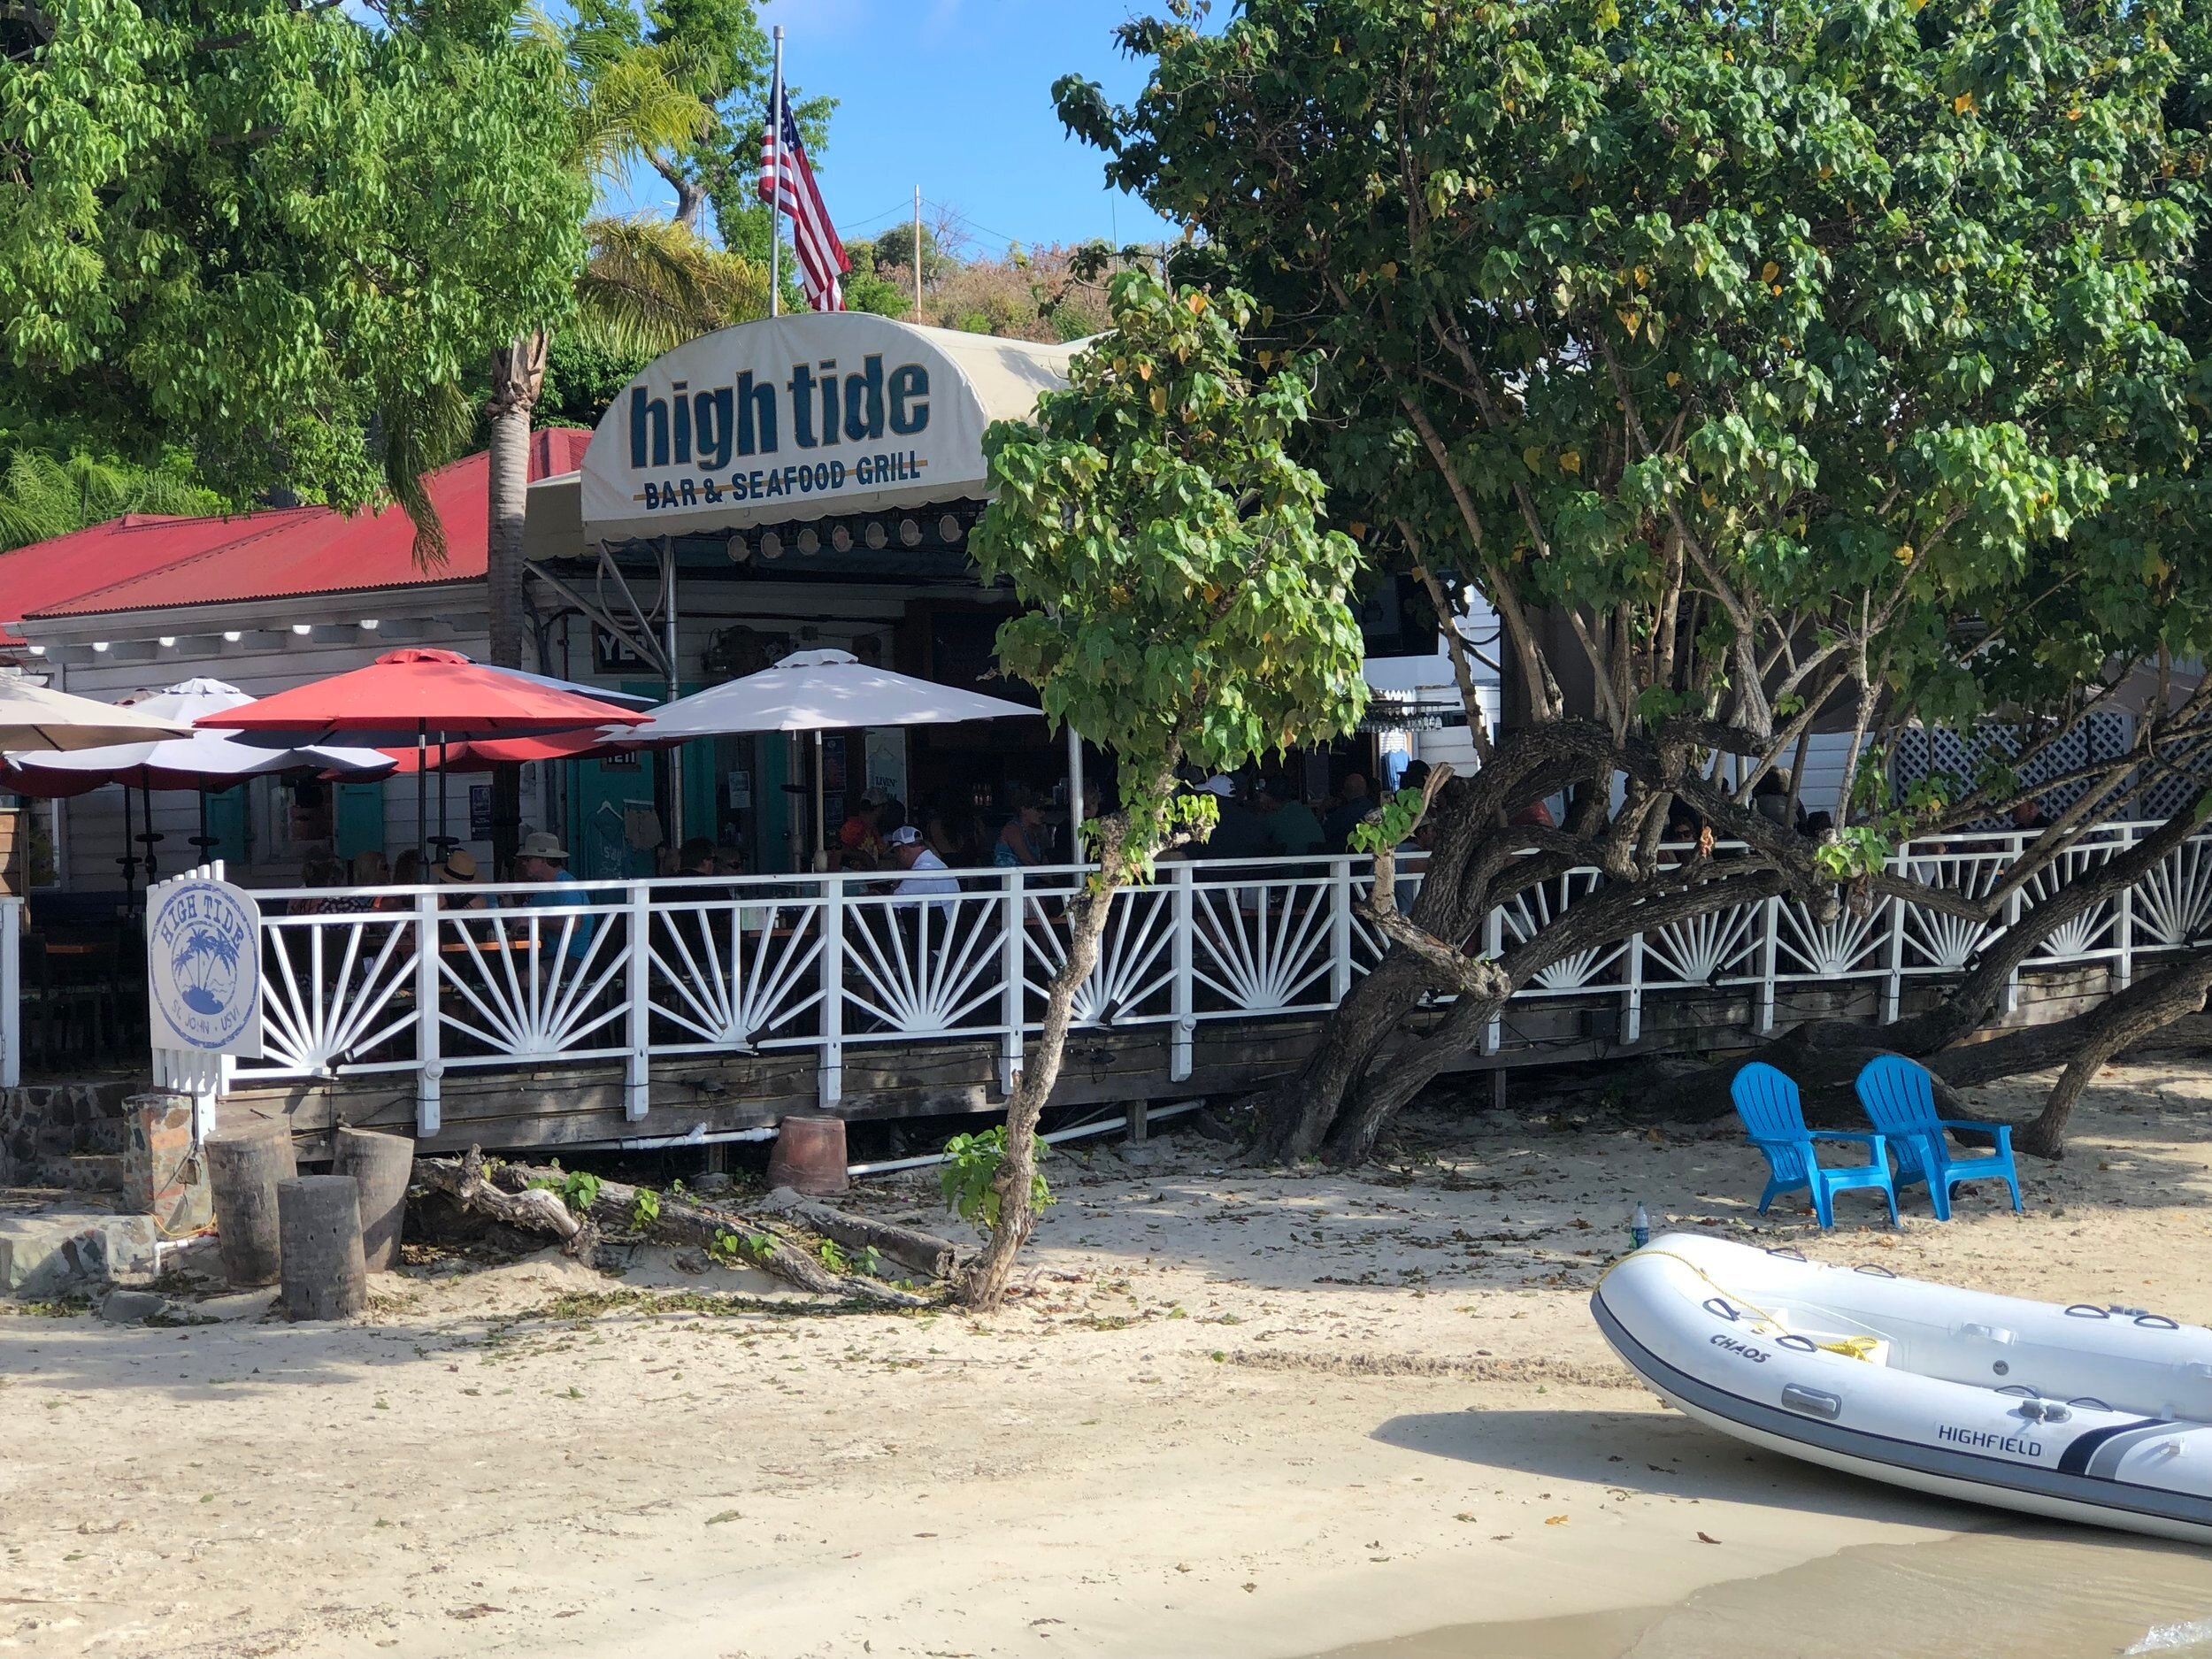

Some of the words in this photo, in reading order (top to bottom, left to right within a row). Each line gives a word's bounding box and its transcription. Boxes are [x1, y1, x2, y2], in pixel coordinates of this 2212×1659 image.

[630, 368, 779, 472] high
[787, 353, 931, 449] tide
[644, 477, 697, 510] BAR
[703, 477, 723, 503] &
[731, 458, 845, 501] SEAFOOD
[856, 449, 921, 485] GRILL
[160, 894, 198, 949] HIGH
[204, 895, 244, 949] TIDE
[184, 1013, 210, 1034] JOHN
[220, 1004, 240, 1031] USVI
[1710, 1334, 1771, 1363] CHAOS
[1939, 1425, 2042, 1457] HIGHFIELD
